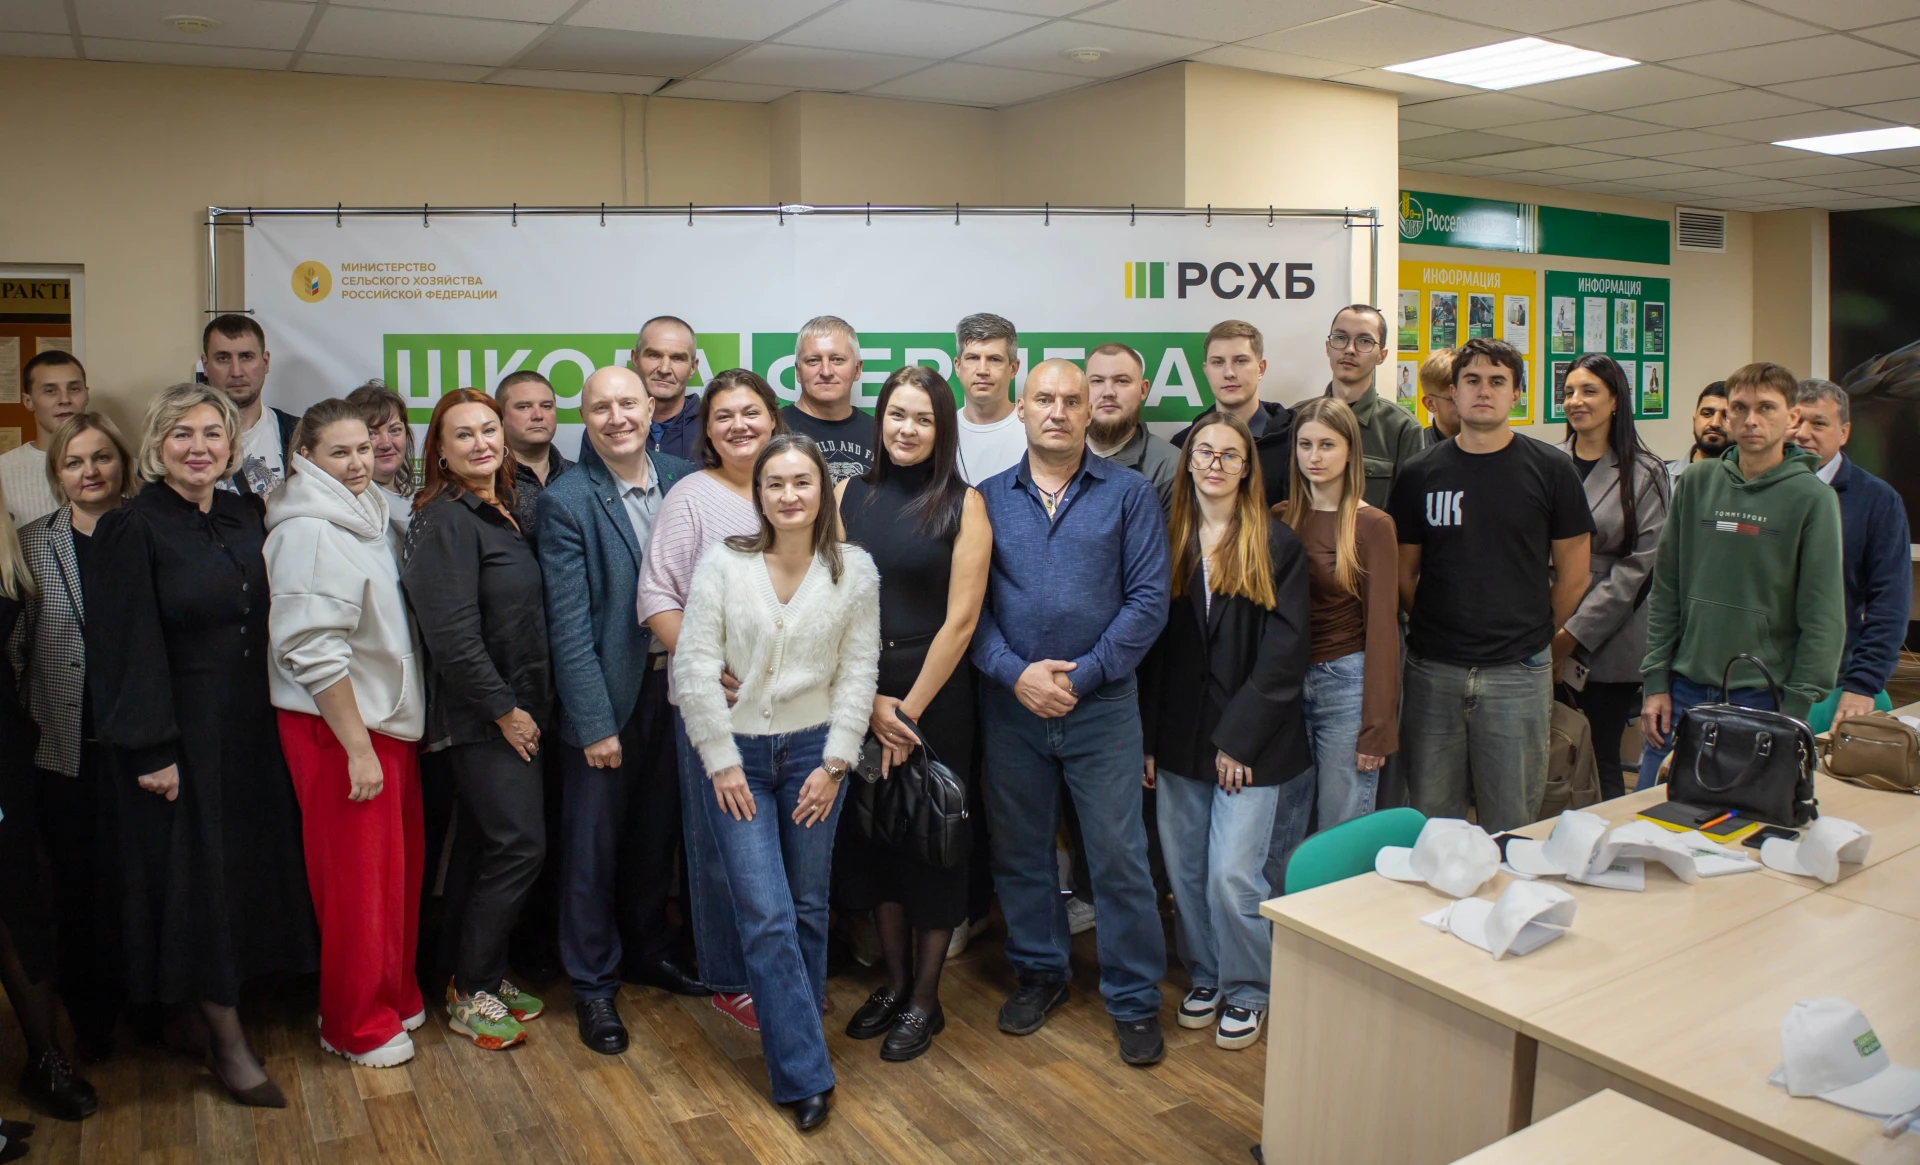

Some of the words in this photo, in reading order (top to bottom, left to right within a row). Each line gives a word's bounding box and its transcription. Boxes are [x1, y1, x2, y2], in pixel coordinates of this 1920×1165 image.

[341, 262, 437, 272] МИНИСТЕРСТВО
[341, 276, 410, 286] СЕЛЬСКОГО
[413, 274, 483, 286] ХОЗЯЙСТВА
[1177, 261, 1316, 300] РСХБ
[1422, 267, 1501, 290] ИНФОРМАЦИЯ
[341, 288, 422, 299] РОССИЙСКОЙ
[425, 290, 498, 300] ФЕДЕРАЦИИ
[1577, 277, 1642, 297] ИНФОРМАЦИЯ
[815, 440, 836, 453] ILD
[840, 440, 861, 456] AND
[1714, 510, 1741, 518] TOMMY
[1742, 513, 1768, 523] SPORT
